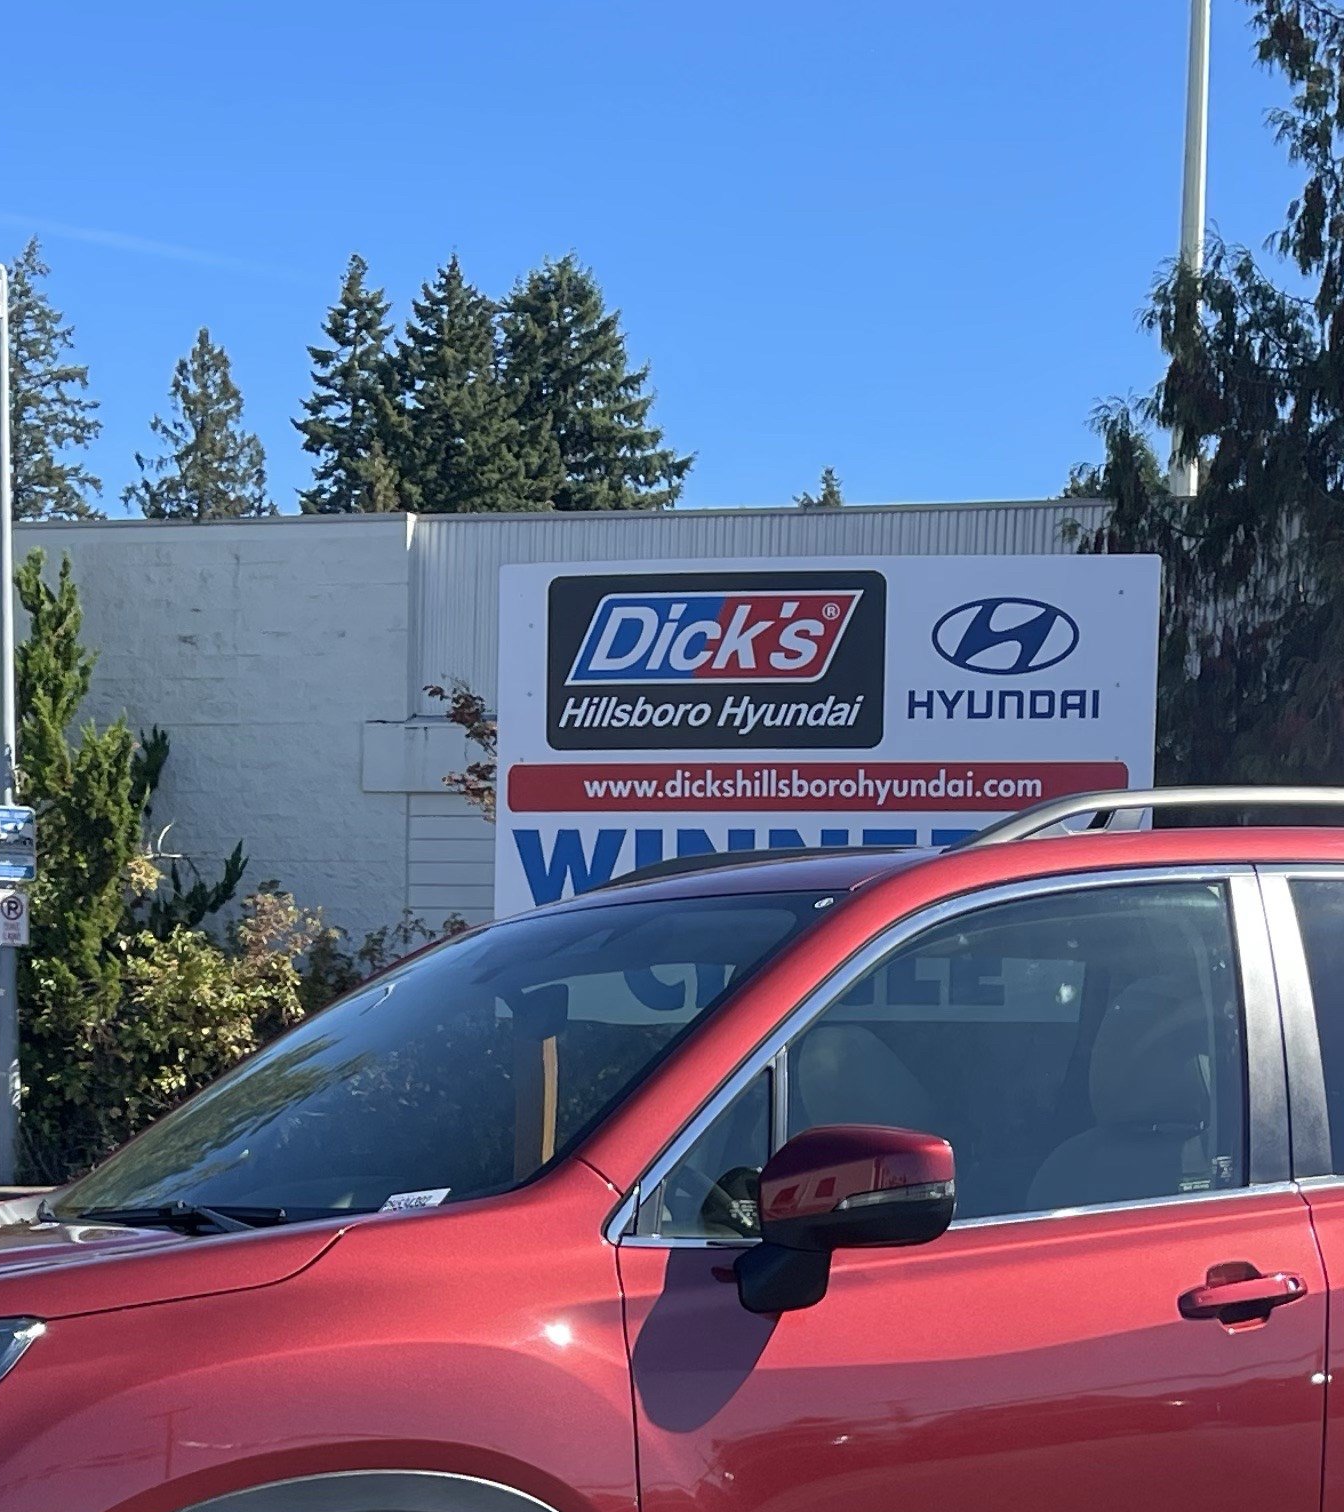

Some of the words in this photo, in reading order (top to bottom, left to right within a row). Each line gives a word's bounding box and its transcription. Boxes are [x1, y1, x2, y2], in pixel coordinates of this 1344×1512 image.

[558, 697, 712, 728] Hillsboro
[716, 695, 865, 735] Hyundai
[907, 689, 1100, 720] HYUNDAI
[583, 768, 1043, 806] www.dickshillsborohyundai.com
